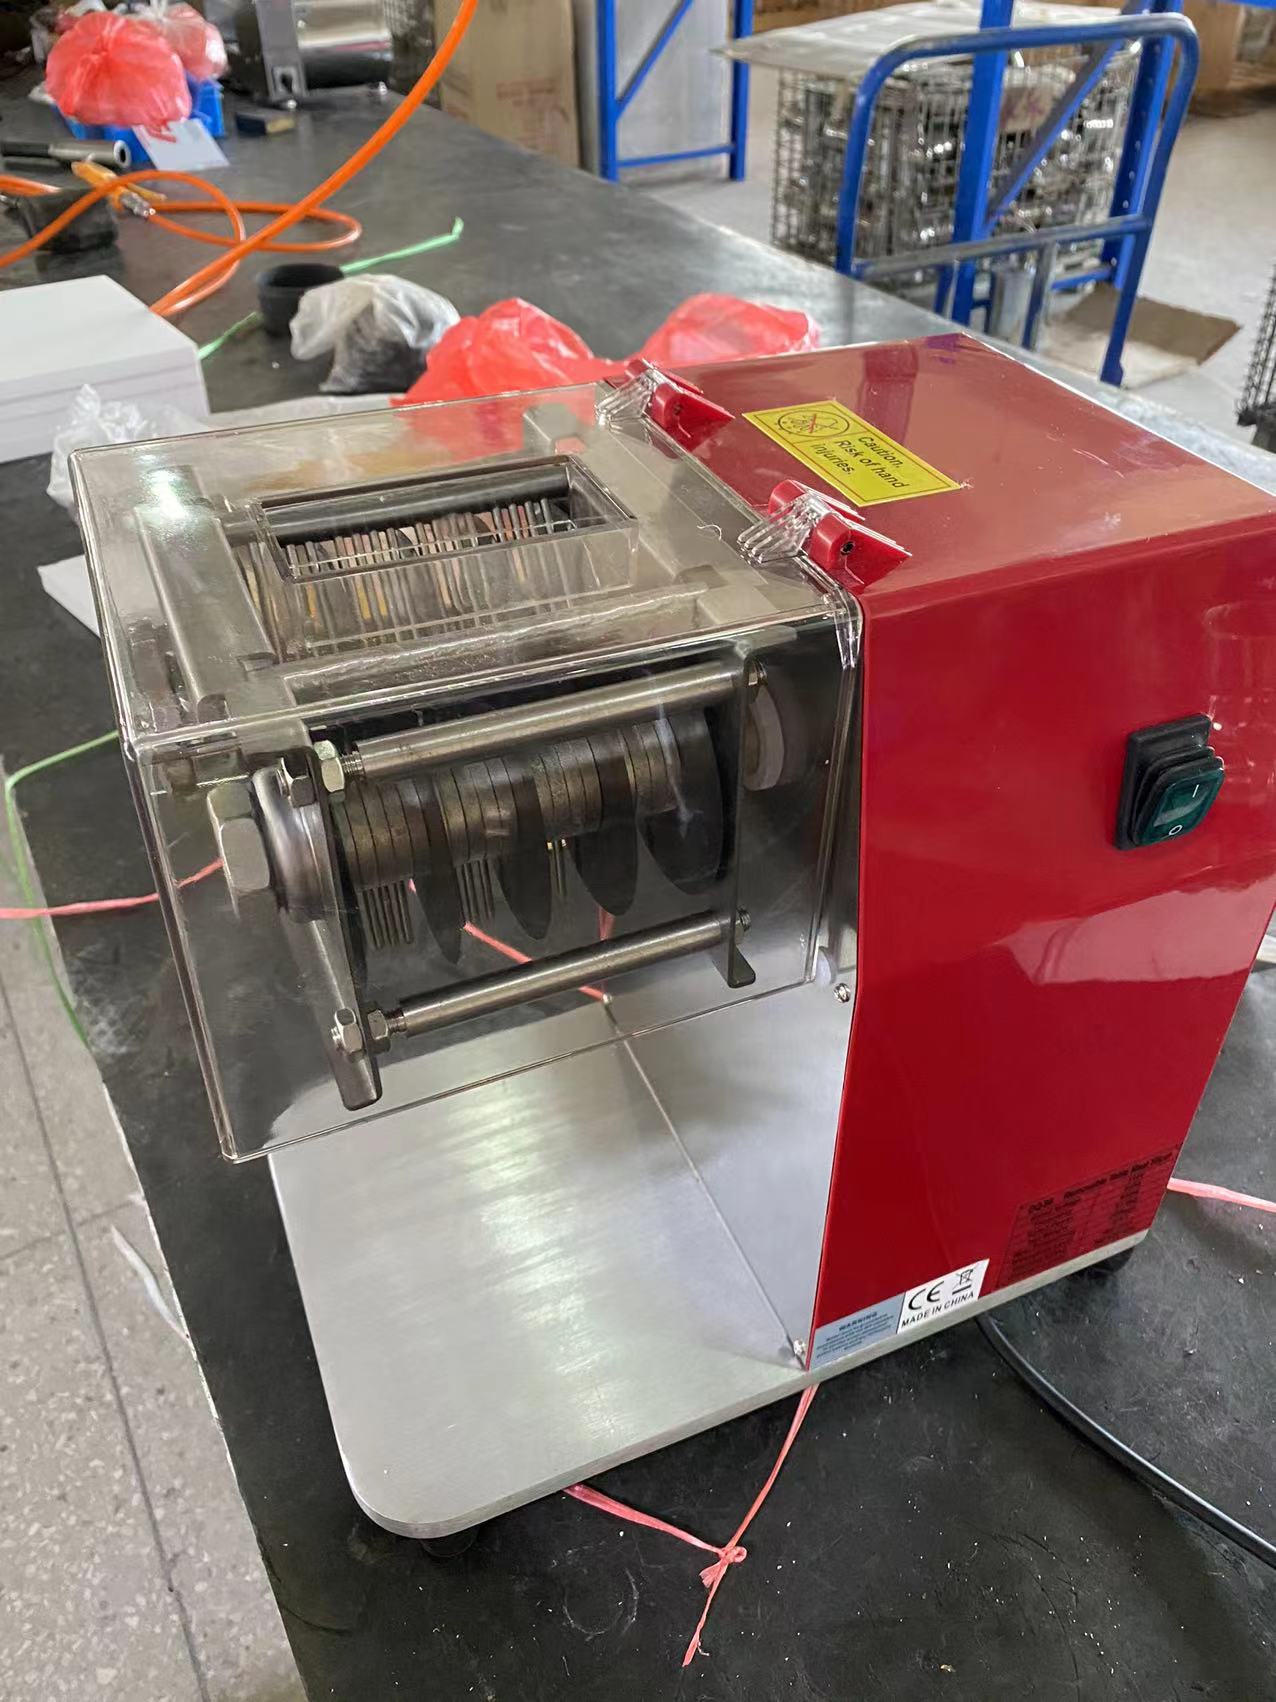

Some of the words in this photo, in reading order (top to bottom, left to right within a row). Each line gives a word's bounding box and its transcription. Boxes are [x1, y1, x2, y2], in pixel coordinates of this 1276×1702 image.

[811, 443, 855, 475] injuries.
[835, 440, 859, 458] Risk
[859, 453, 876, 468] of
[872, 464, 909, 488] hand
[858, 436, 904, 469] Caution.
[901, 1311, 930, 1327] MADE
[931, 1304, 942, 1315] IN
[943, 1291, 974, 1309] CHINA
[908, 1281, 944, 1311] CE
[838, 1311, 878, 1331] WARNING
